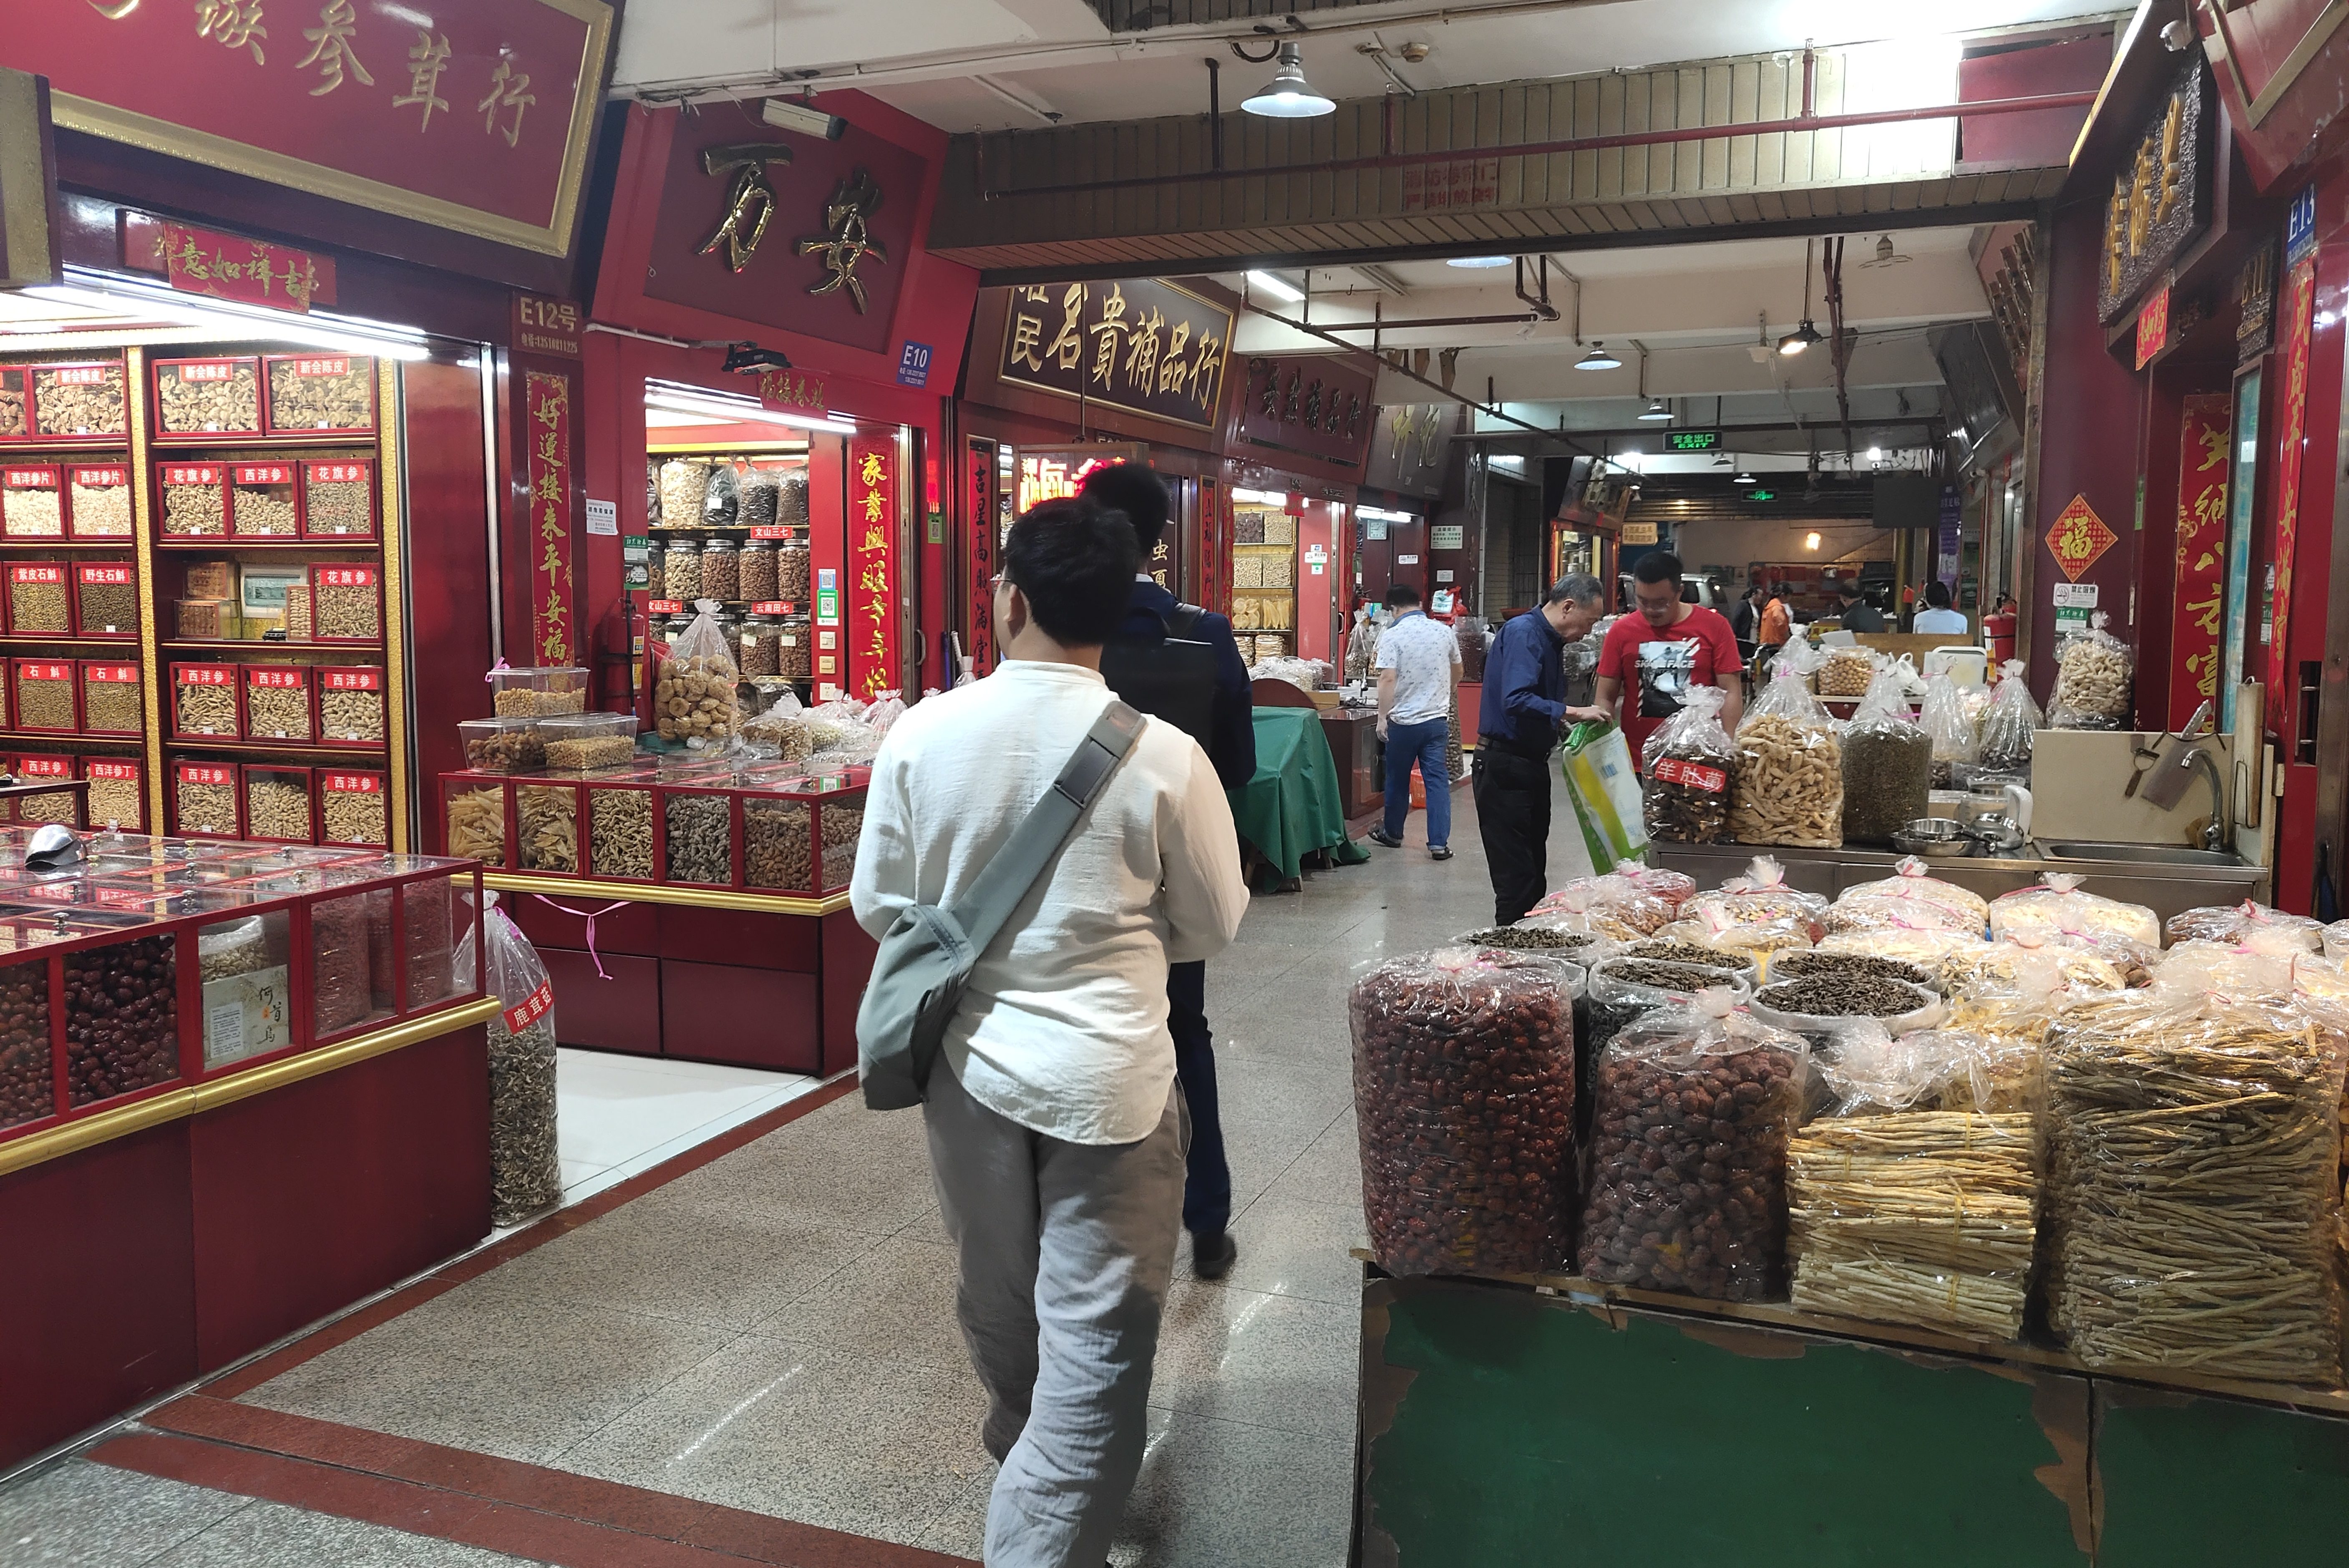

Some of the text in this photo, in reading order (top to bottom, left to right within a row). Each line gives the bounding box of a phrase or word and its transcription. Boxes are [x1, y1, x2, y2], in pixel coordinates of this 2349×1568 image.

[521, 296, 577, 332] E12号
[903, 345, 928, 368] E10
[185, 365, 228, 379] 新会陈皮
[300, 360, 344, 374] 新会陈皮
[1672, 434, 1715, 444] 安全出口
[10, 472, 50, 484] 西洋参片
[80, 471, 121, 484] 西洋参片
[174, 469, 211, 482] 花旗参
[244, 468, 282, 481] 西洋参
[318, 466, 358, 480] 花旗参
[755, 527, 788, 537] 文山三七
[2058, 516, 2093, 560] 福
[18, 569, 57, 581] 紫皮石斛
[85, 569, 125, 582] 野生石斛
[327, 570, 366, 584] 花旗参
[756, 603, 790, 613] 云南田七
[29, 666, 60, 678] 石斛
[96, 668, 128, 680] 石斛
[188, 670, 224, 683] 西洋参
[258, 672, 295, 685] 西洋参
[333, 674, 370, 687] 西洋参
[28, 760, 62, 774] 西洋参
[95, 764, 131, 778] 西洋参丁
[188, 768, 224, 782] 西洋参
[1657, 760, 1722, 792] 羊肚菌
[334, 776, 371, 790] 西洋参
[513, 986, 552, 1028] 鹿茸菇
